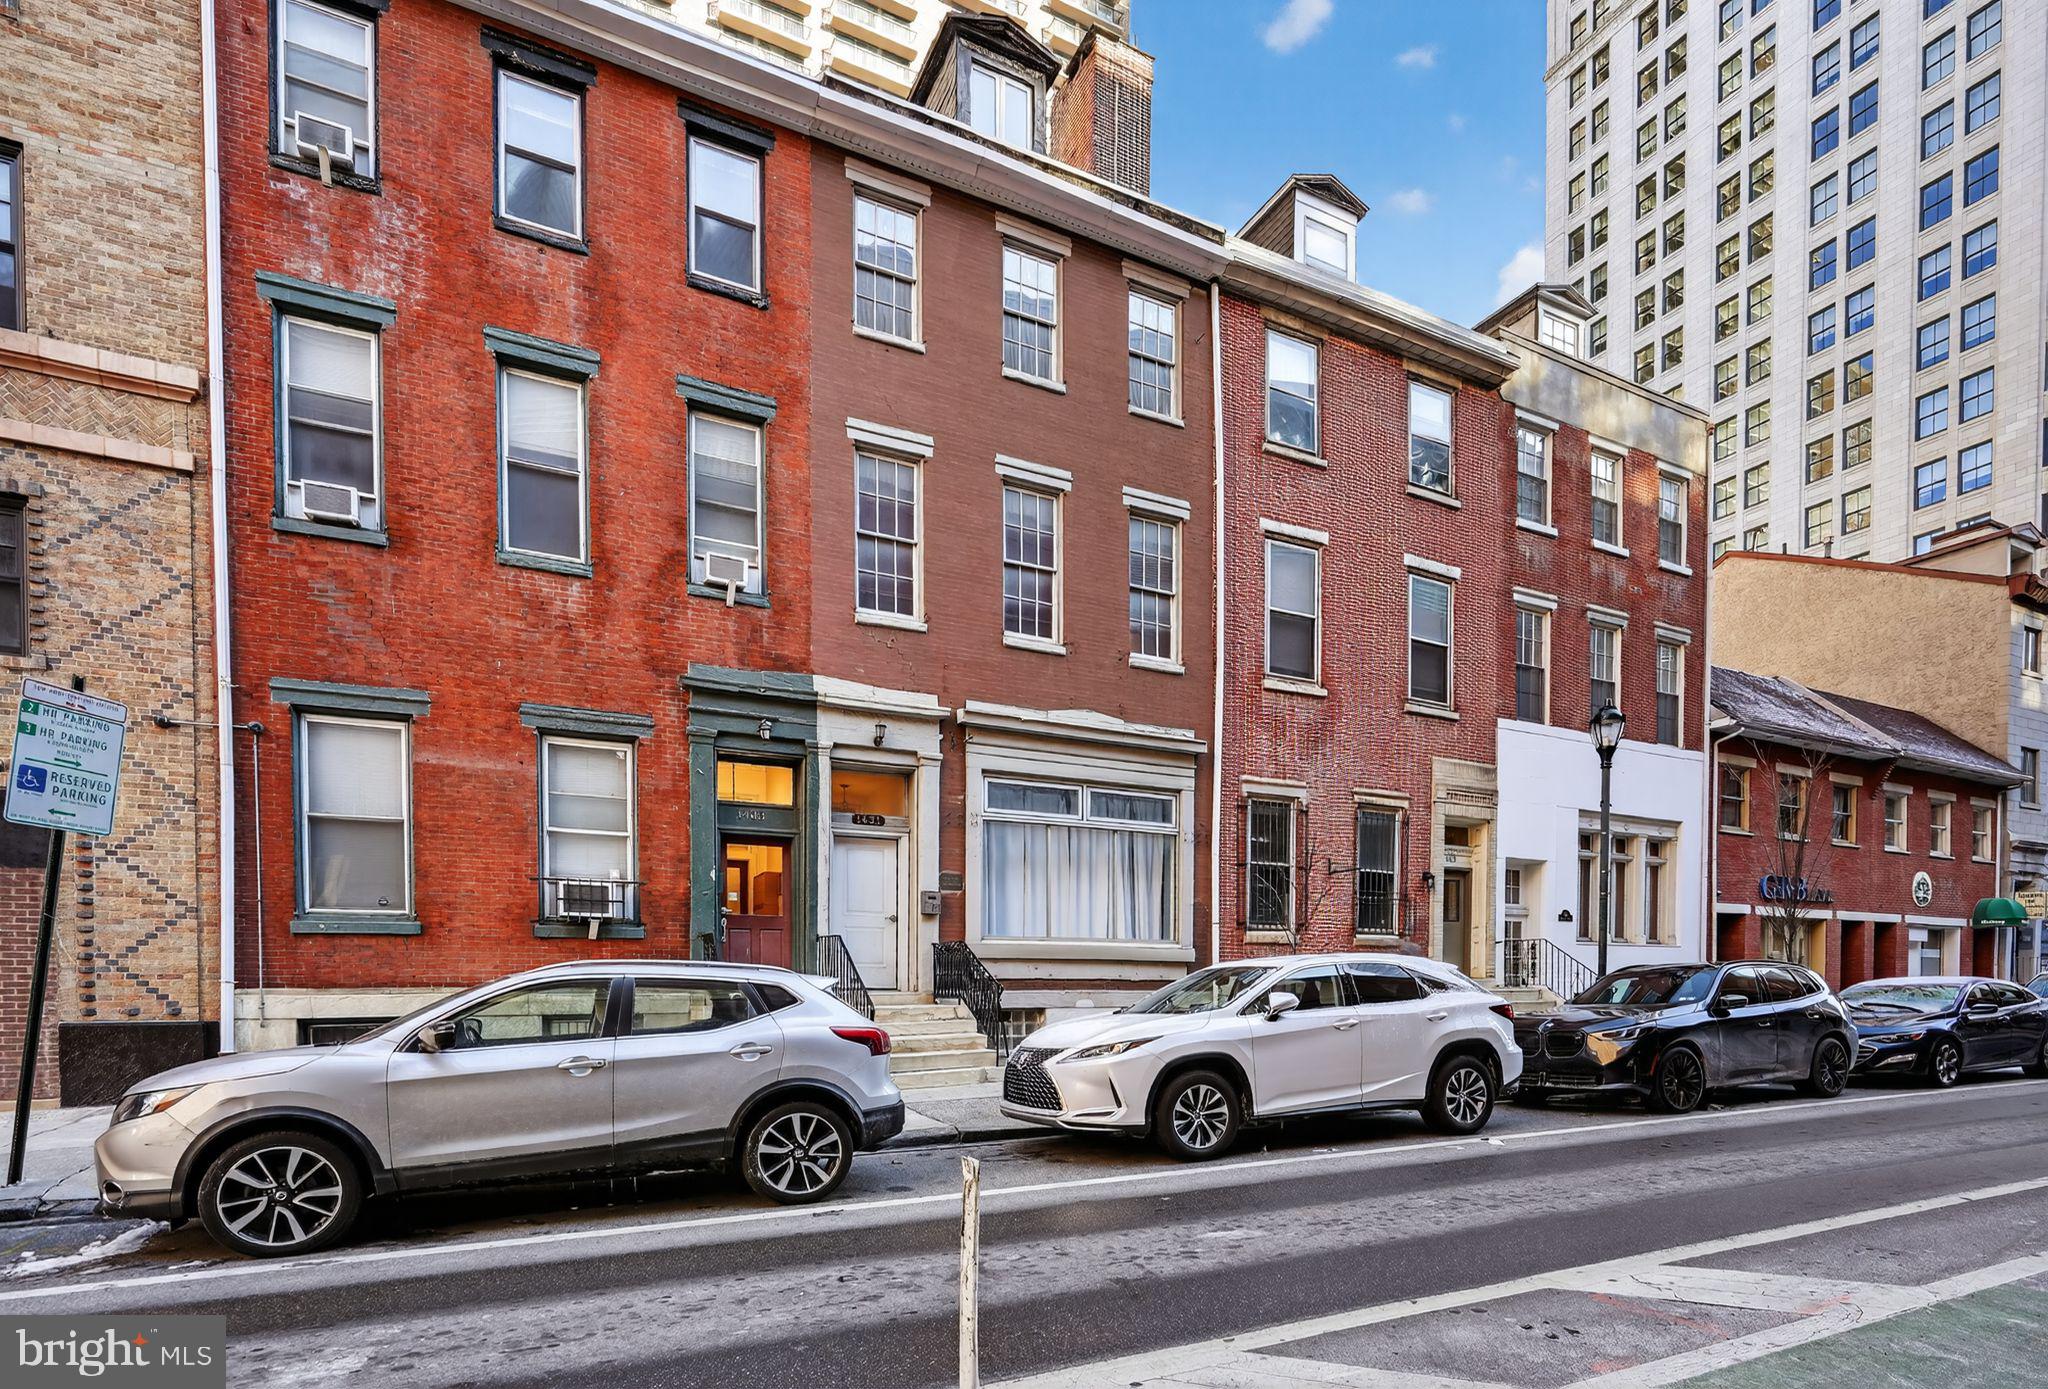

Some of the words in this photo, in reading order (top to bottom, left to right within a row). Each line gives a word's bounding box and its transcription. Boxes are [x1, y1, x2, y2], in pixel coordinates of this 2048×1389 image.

[61, 730, 107, 751] PARKING
[50, 771, 112, 793] RESERVED
[52, 785, 107, 806] PARKING
